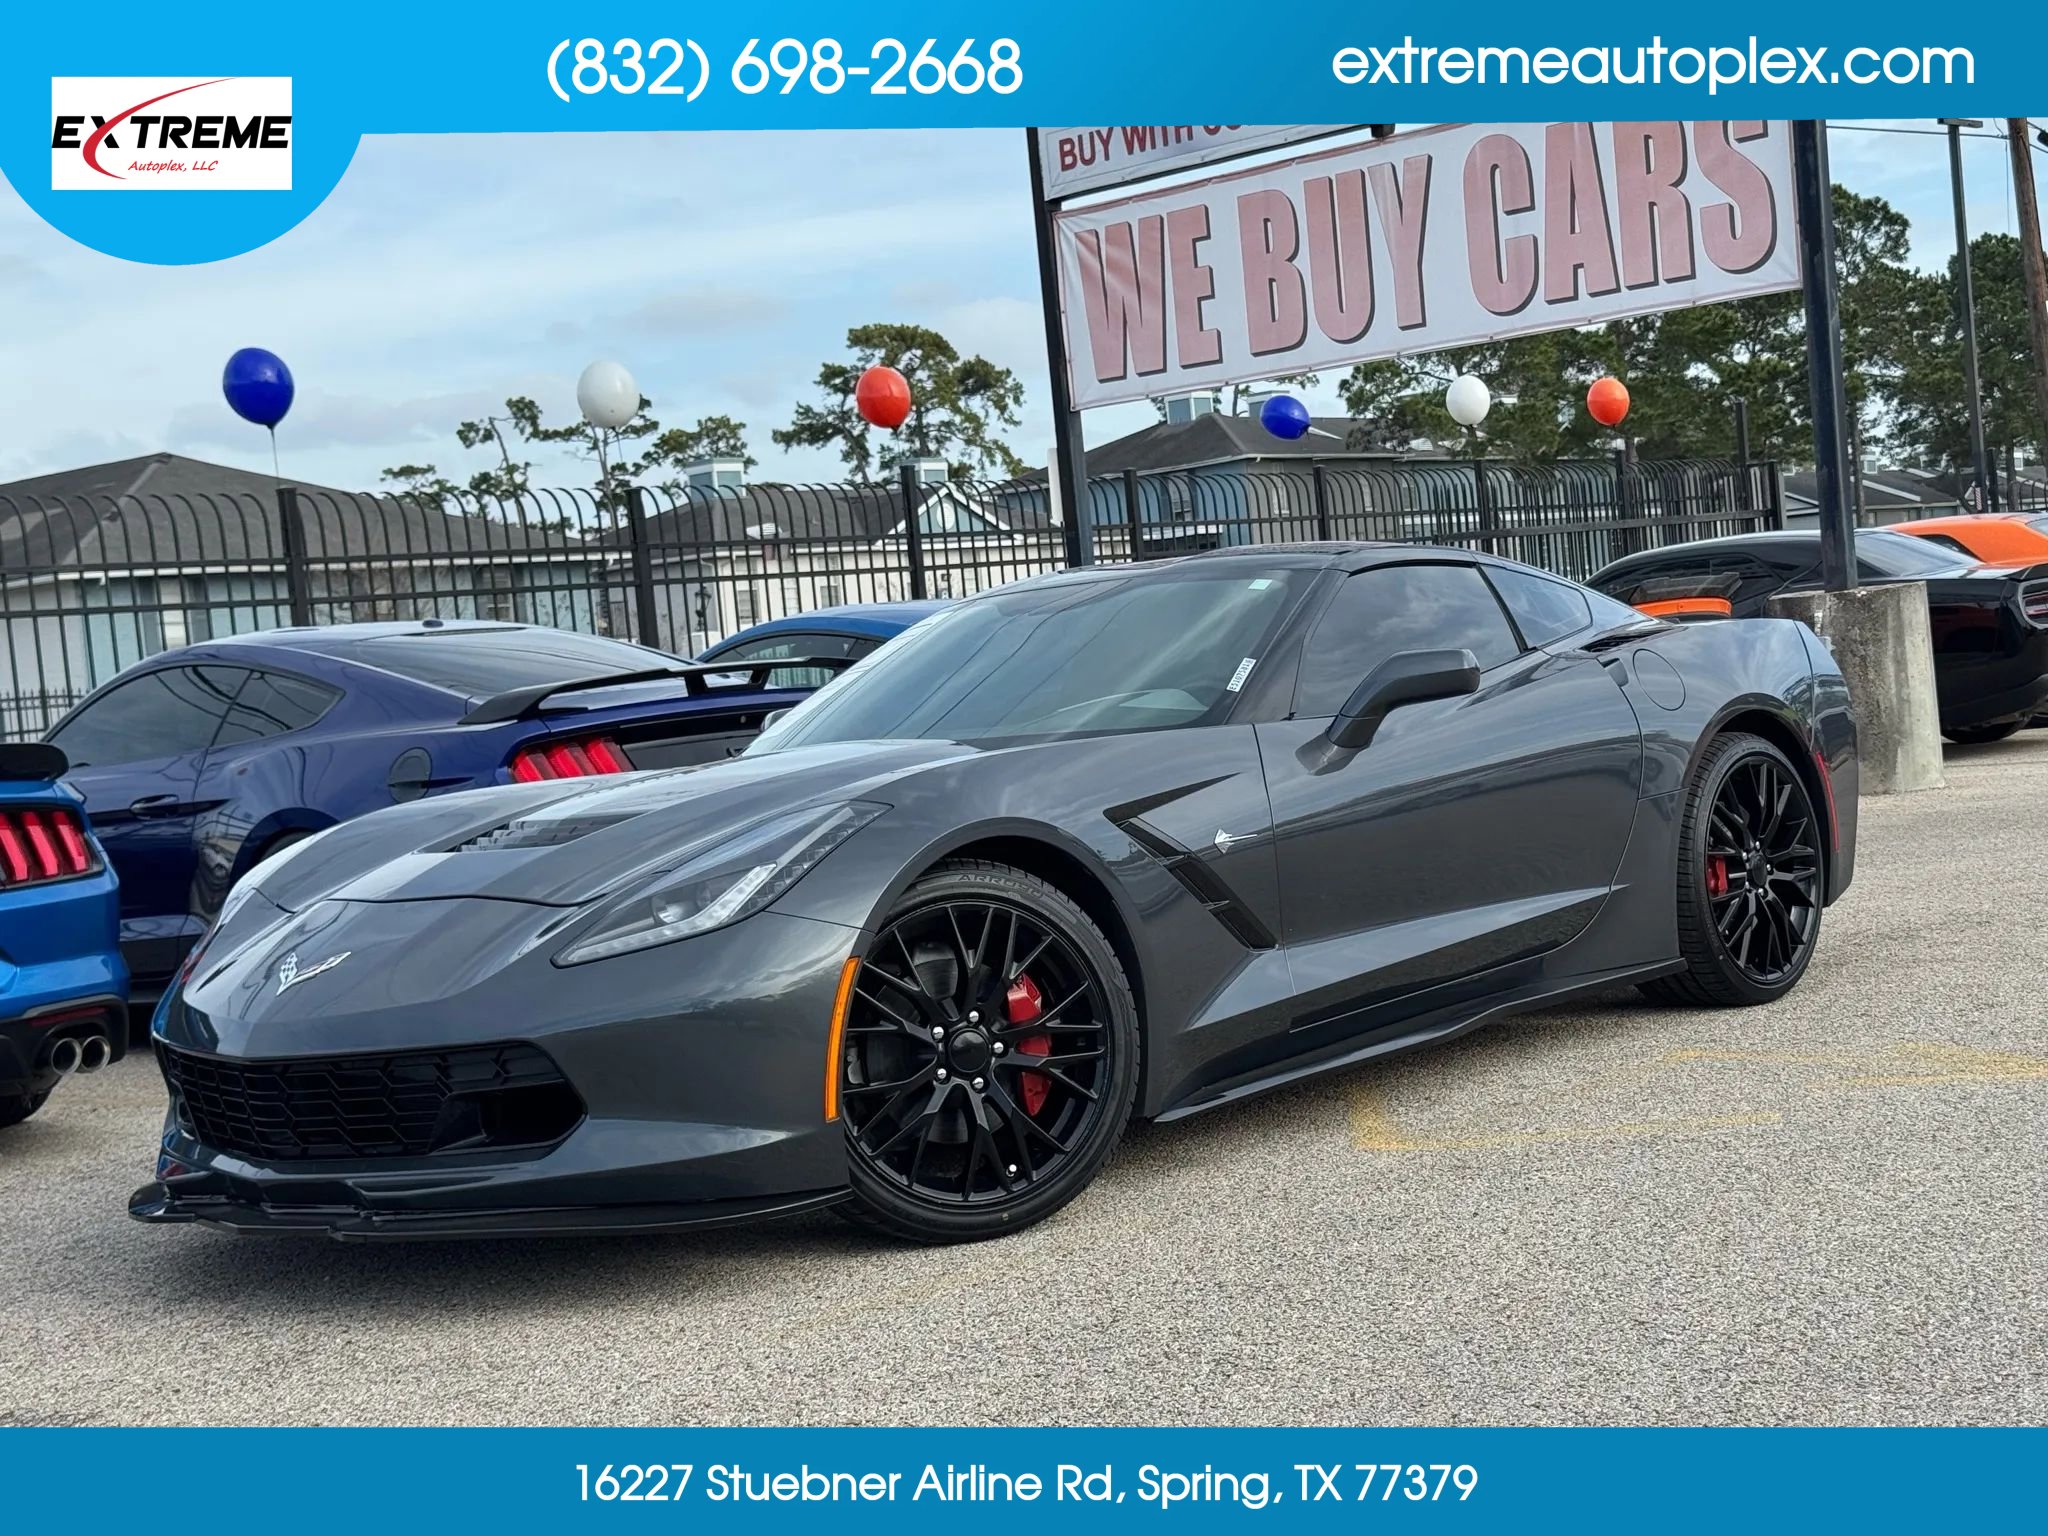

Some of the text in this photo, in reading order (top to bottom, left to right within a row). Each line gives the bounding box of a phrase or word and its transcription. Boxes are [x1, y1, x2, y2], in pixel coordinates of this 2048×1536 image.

[1059, 127, 1114, 171] BUY
[1074, 121, 1776, 382] WE BUY CARS
